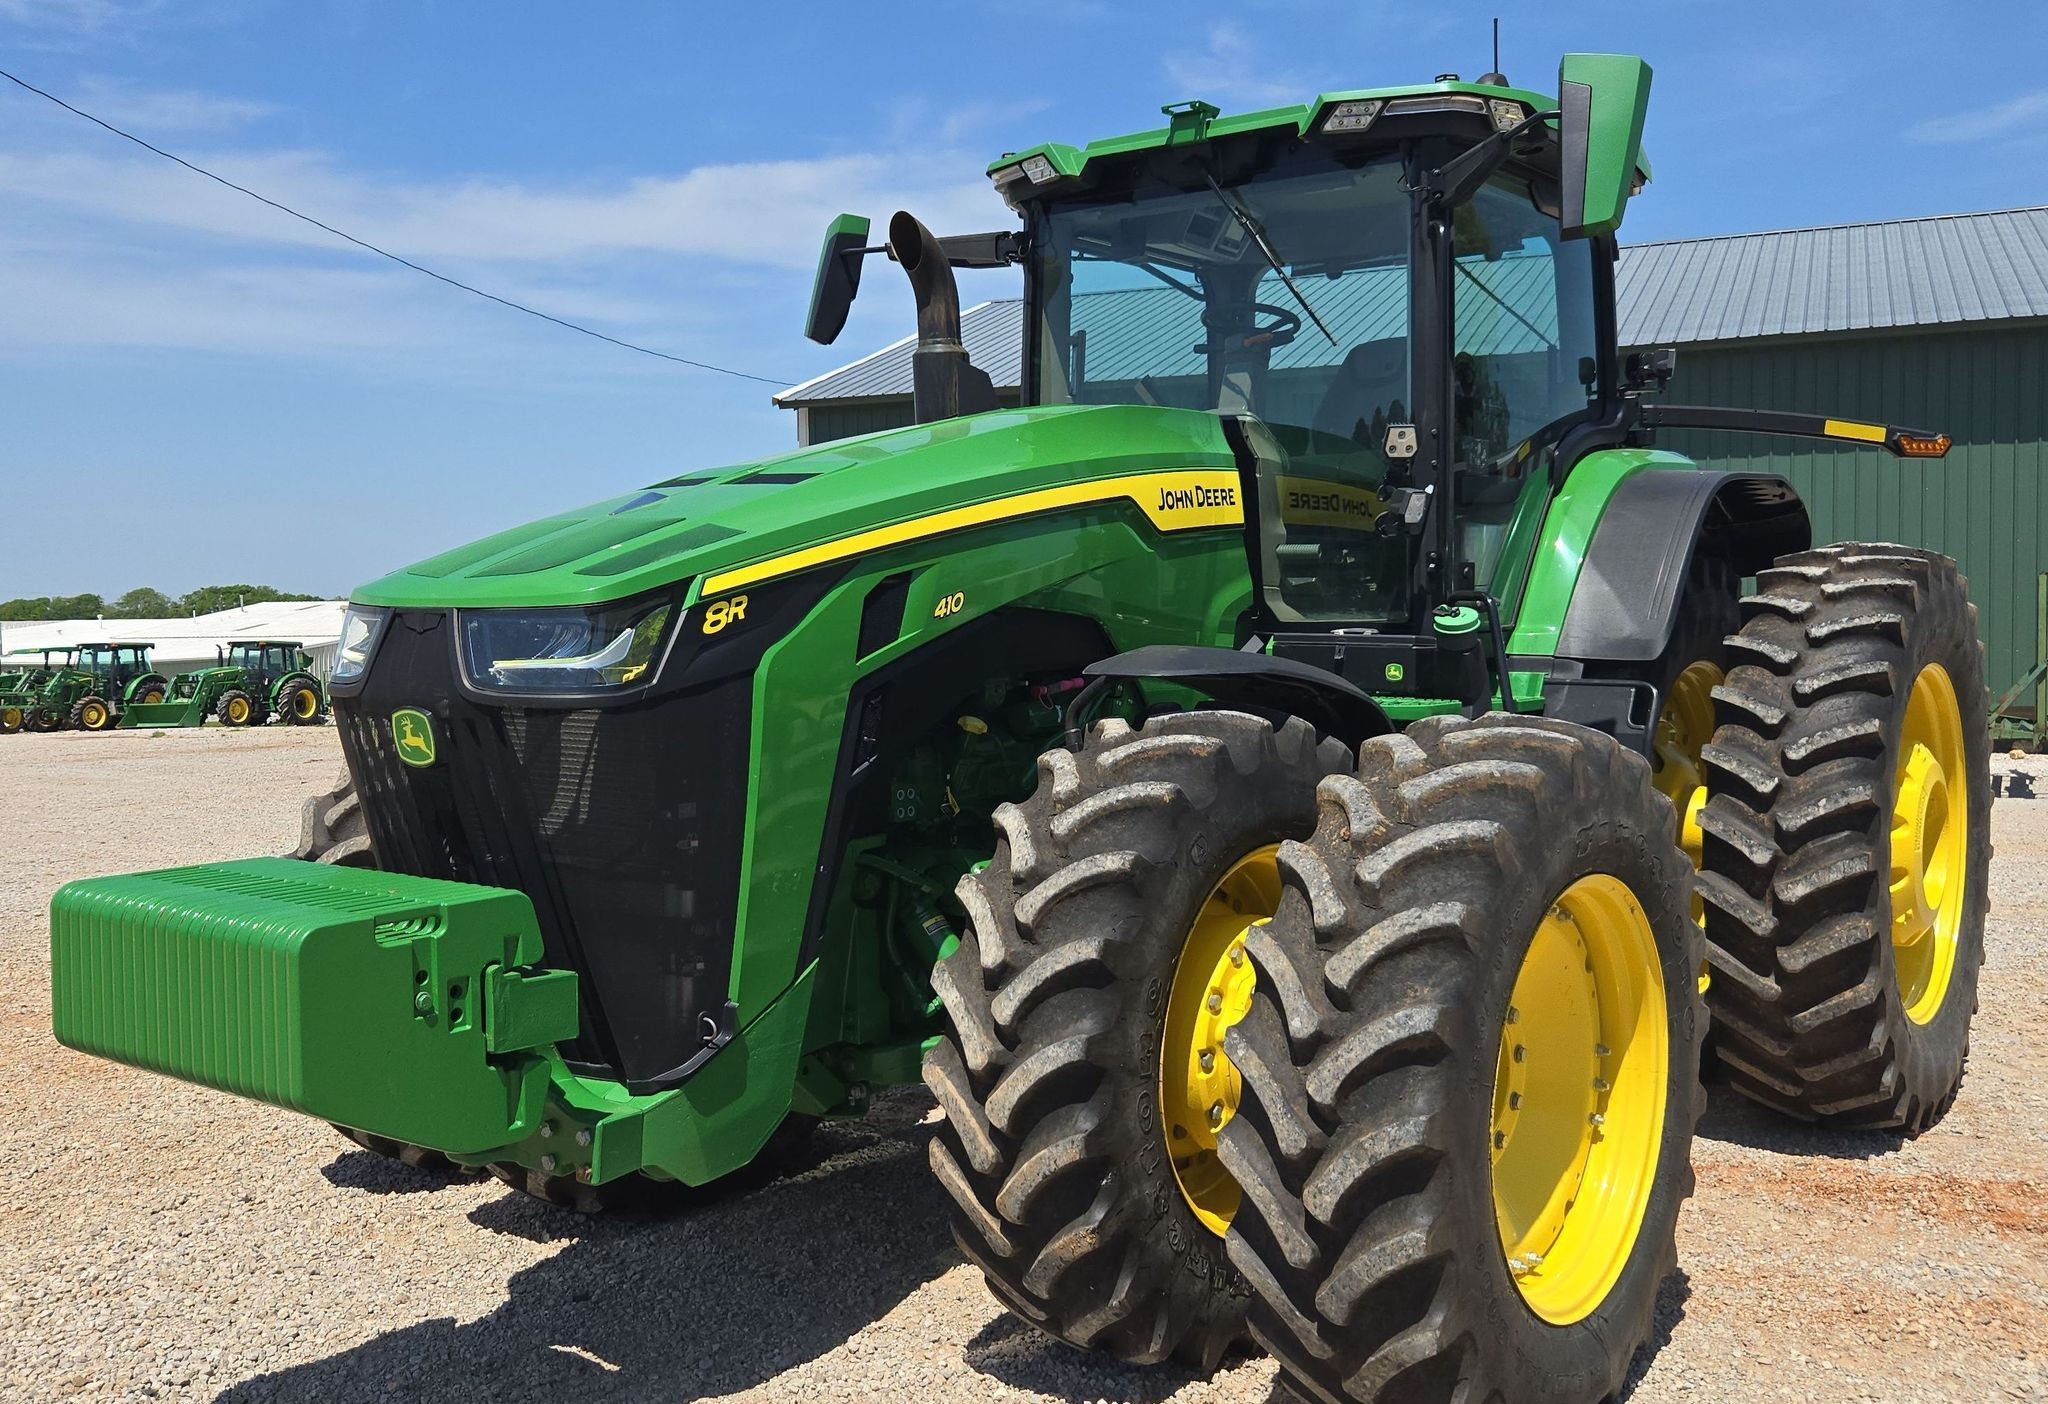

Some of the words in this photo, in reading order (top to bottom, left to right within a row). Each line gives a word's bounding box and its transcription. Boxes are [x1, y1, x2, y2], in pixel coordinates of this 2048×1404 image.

[1158, 487, 1194, 511] JOHN
[1195, 485, 1236, 507] DEERE
[702, 594, 748, 635] 8R
[933, 591, 966, 619] 410
